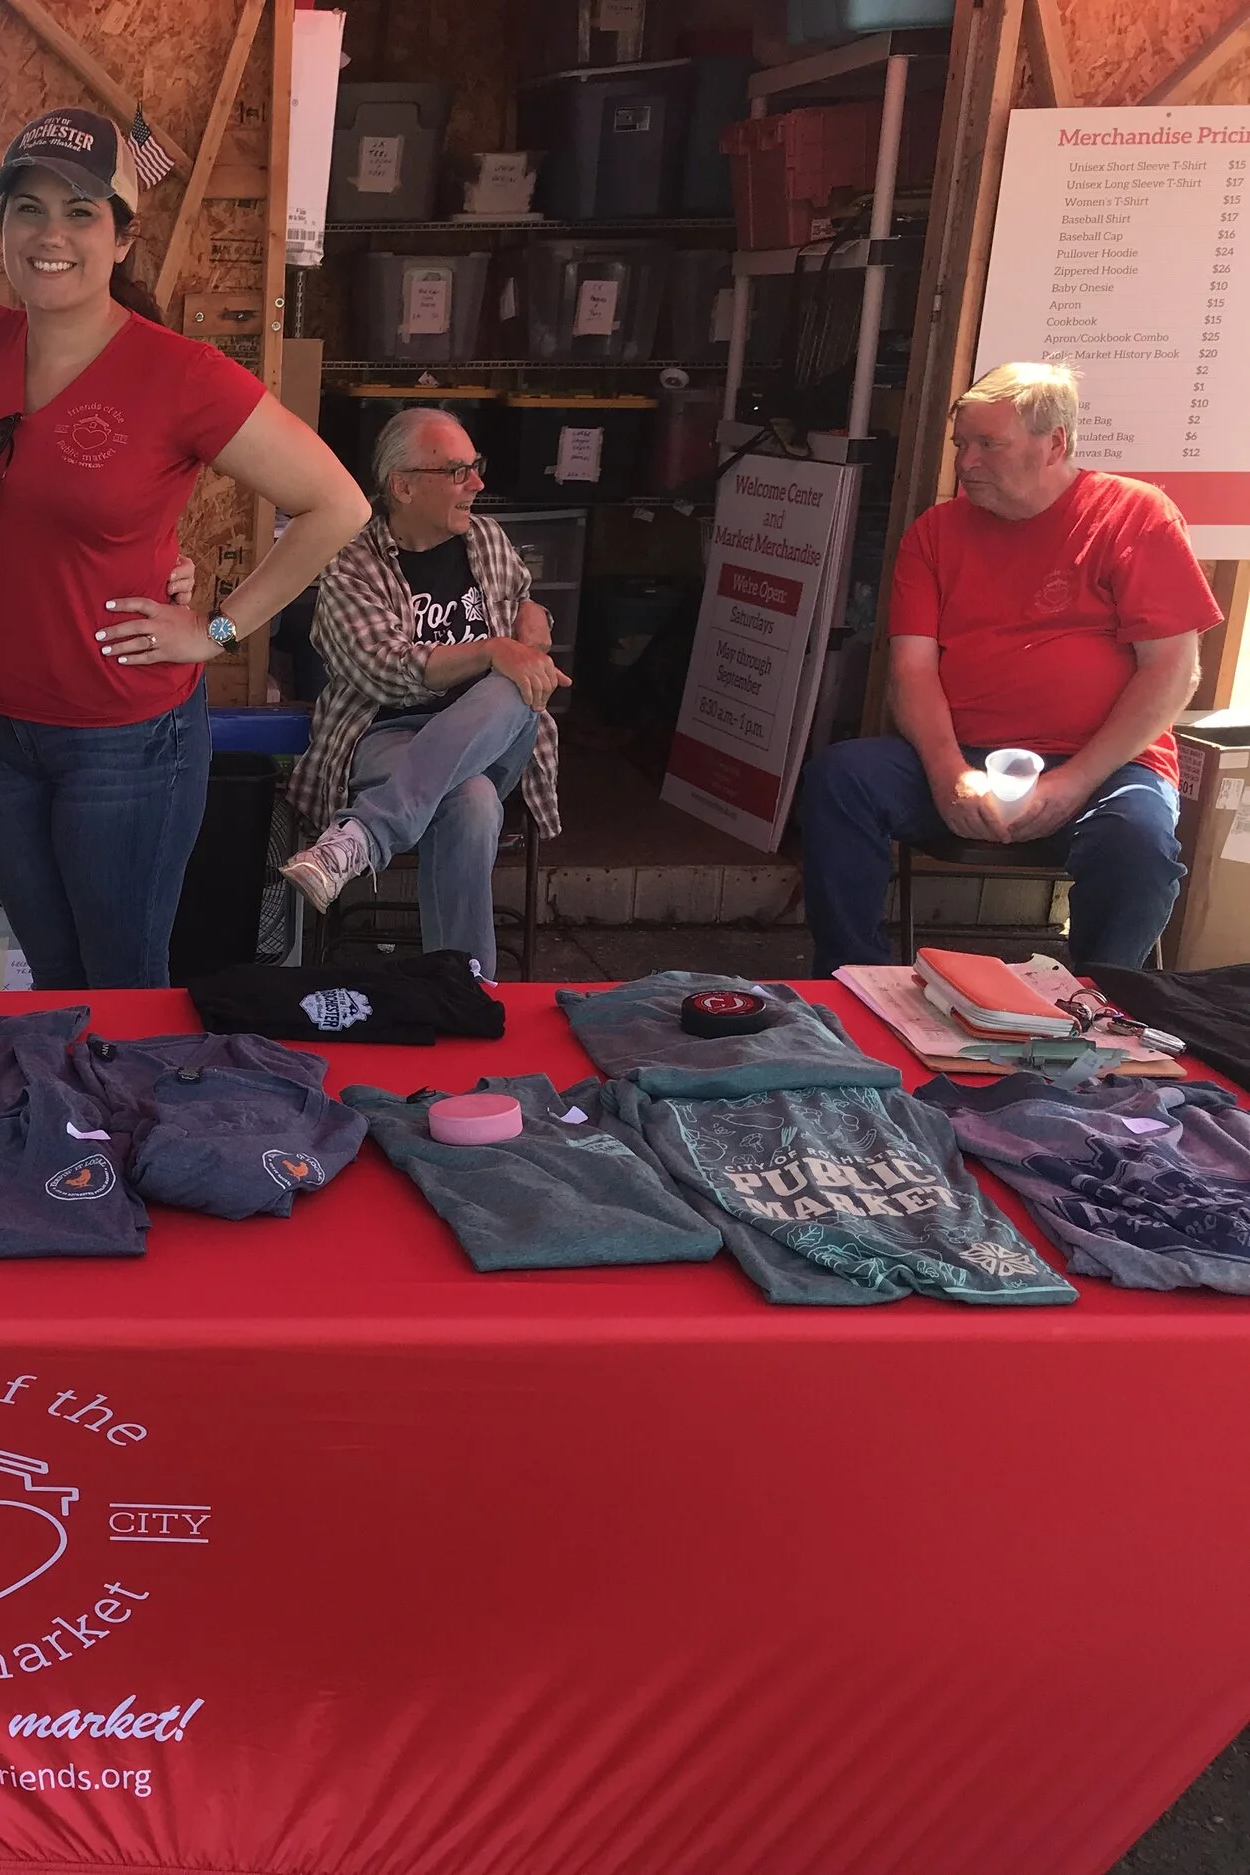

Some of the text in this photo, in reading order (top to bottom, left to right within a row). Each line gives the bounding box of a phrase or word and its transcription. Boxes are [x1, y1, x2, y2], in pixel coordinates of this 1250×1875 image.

[18, 124, 94, 151] ROCHESTER
[1058, 127, 1192, 147] Merchandise
[49, 138, 82, 152] Market
[1069, 159, 1247, 173] Unisex Short Sleeve T-Shirt $15
[1066, 177, 1244, 191] Unisex Long Sleeve T-Shirt $17
[1064, 195, 1241, 207] Women's T-Shirt $15
[1061, 212, 1239, 225] Baseball Shirt $17
[1059, 229, 1236, 243] Baseball Cap $16
[1056, 246, 1234, 260] Pullover Hoodie $24
[1054, 263, 1231, 278] Zippered Hoodie $26
[1051, 280, 1228, 295] Baby Onesie $10
[1049, 298, 1225, 312] Apron $15
[1046, 315, 1222, 327] Cookbook $15
[1044, 331, 1220, 345] Apron/Cookbook Combo $25
[1074, 349, 1112, 360] Market
[1113, 349, 1152, 361] History
[1154, 348, 1180, 360] Book
[1198, 348, 1217, 359] $20
[1195, 364, 1209, 376] $2
[1193, 382, 1205, 393] $1
[67, 402, 102, 417] friends
[1078, 398, 1209, 411] ug $10
[1094, 416, 1112, 427] Bag
[1187, 415, 1201, 426] $2
[1077, 431, 1198, 443] sulated Bag $6
[82, 447, 117, 462] market
[1104, 447, 1200, 460] Bag $12
[736, 474, 824, 508] Welcome Center
[763, 509, 786, 530] and
[714, 525, 821, 567] Market Merchandise
[733, 573, 788, 604] We're Open:
[729, 605, 775, 635] Saturdays
[716, 639, 772, 677] May through
[716, 664, 762, 696] September
[724, 1147, 908, 1173] CITY OF ROCHESTER
[723, 1156, 938, 1198] PUBLIC
[740, 1183, 961, 1221] MARKET
[46, 1386, 149, 1447] the
[108, 1512, 213, 1536] CITY
[8, 1693, 206, 1742] market!
